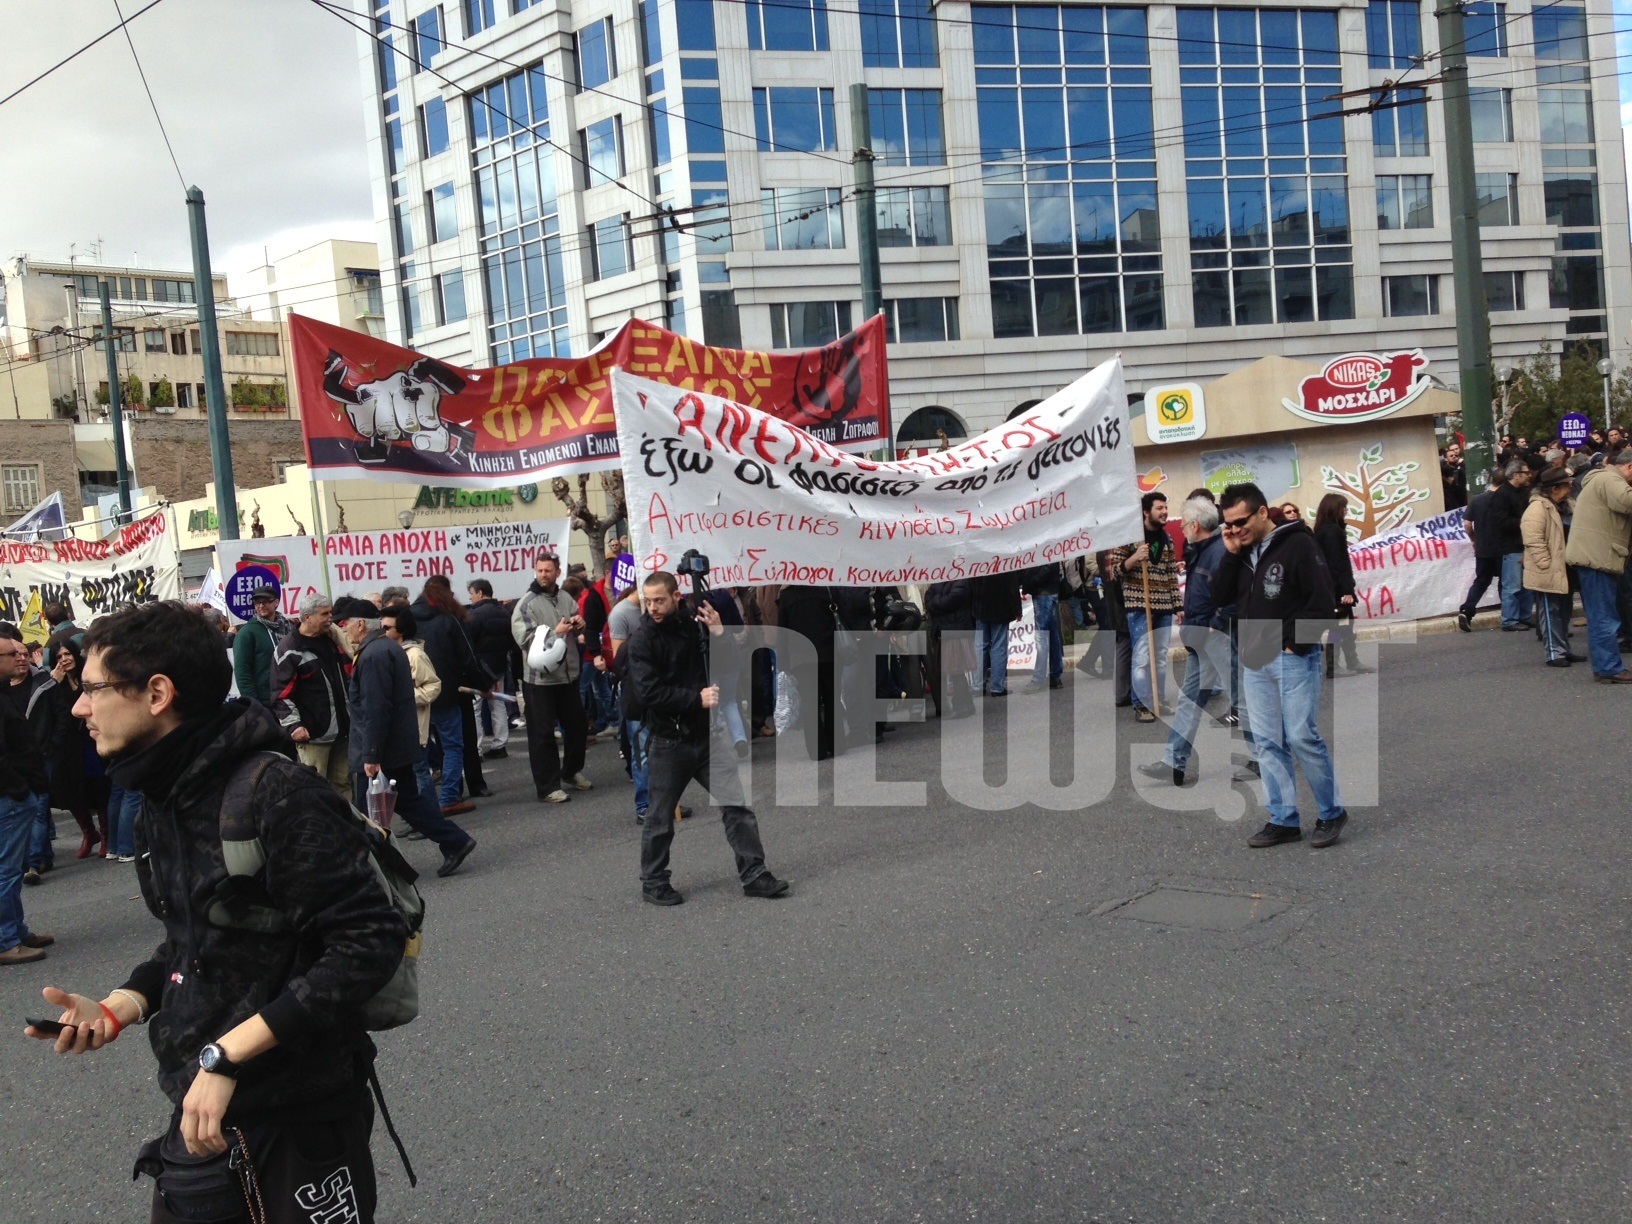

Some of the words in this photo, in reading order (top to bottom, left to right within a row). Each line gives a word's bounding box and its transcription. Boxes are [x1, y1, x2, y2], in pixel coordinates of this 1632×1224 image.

[631, 329, 773, 375] ΞΑΝΑ
[1333, 362, 1375, 383] NIKAS
[1318, 387, 1397, 412] ΜΟΣΧΑΡΙ
[468, 452, 515, 472] ΚΙΝΗΣΗ
[519, 441, 583, 469] ΕΝΩΜΕΝΟΙ
[734, 458, 780, 489] οι
[935, 466, 988, 495] από
[414, 484, 516, 509] ATEbank
[649, 492, 839, 539] Αντιφασιστικές
[380, 530, 447, 555] ΑΝΟΧΗ
[466, 523, 533, 538] ΜΝΗΜΟΝΙΑ
[486, 535, 522, 549] ΧΡΥΣΗ
[335, 560, 387, 581] ΠΟΤΕ
[402, 556, 454, 578] ΞΑΝΑ
